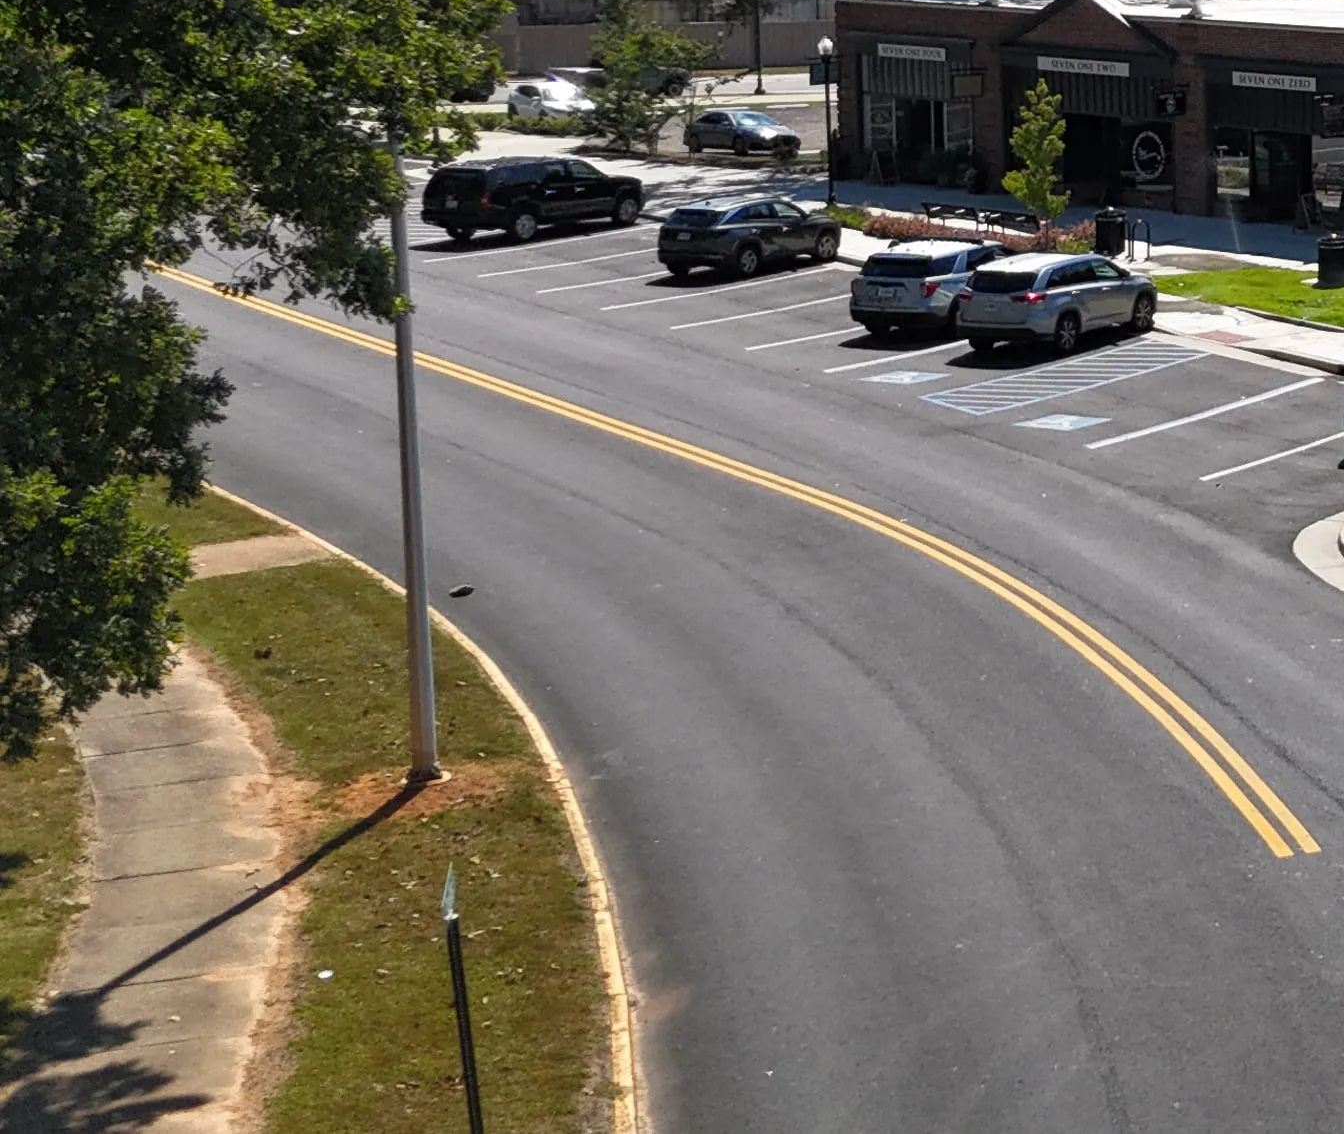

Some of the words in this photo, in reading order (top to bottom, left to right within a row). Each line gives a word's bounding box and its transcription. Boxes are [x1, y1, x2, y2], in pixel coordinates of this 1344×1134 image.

[1051, 59, 1075, 71] SEVEN
[1077, 61, 1094, 72] ONE
[1096, 63, 1116, 73] TWO
[1238, 75, 1265, 86] SEVEN
[1267, 77, 1286, 87] ONE
[1288, 78, 1311, 88] ZERO
